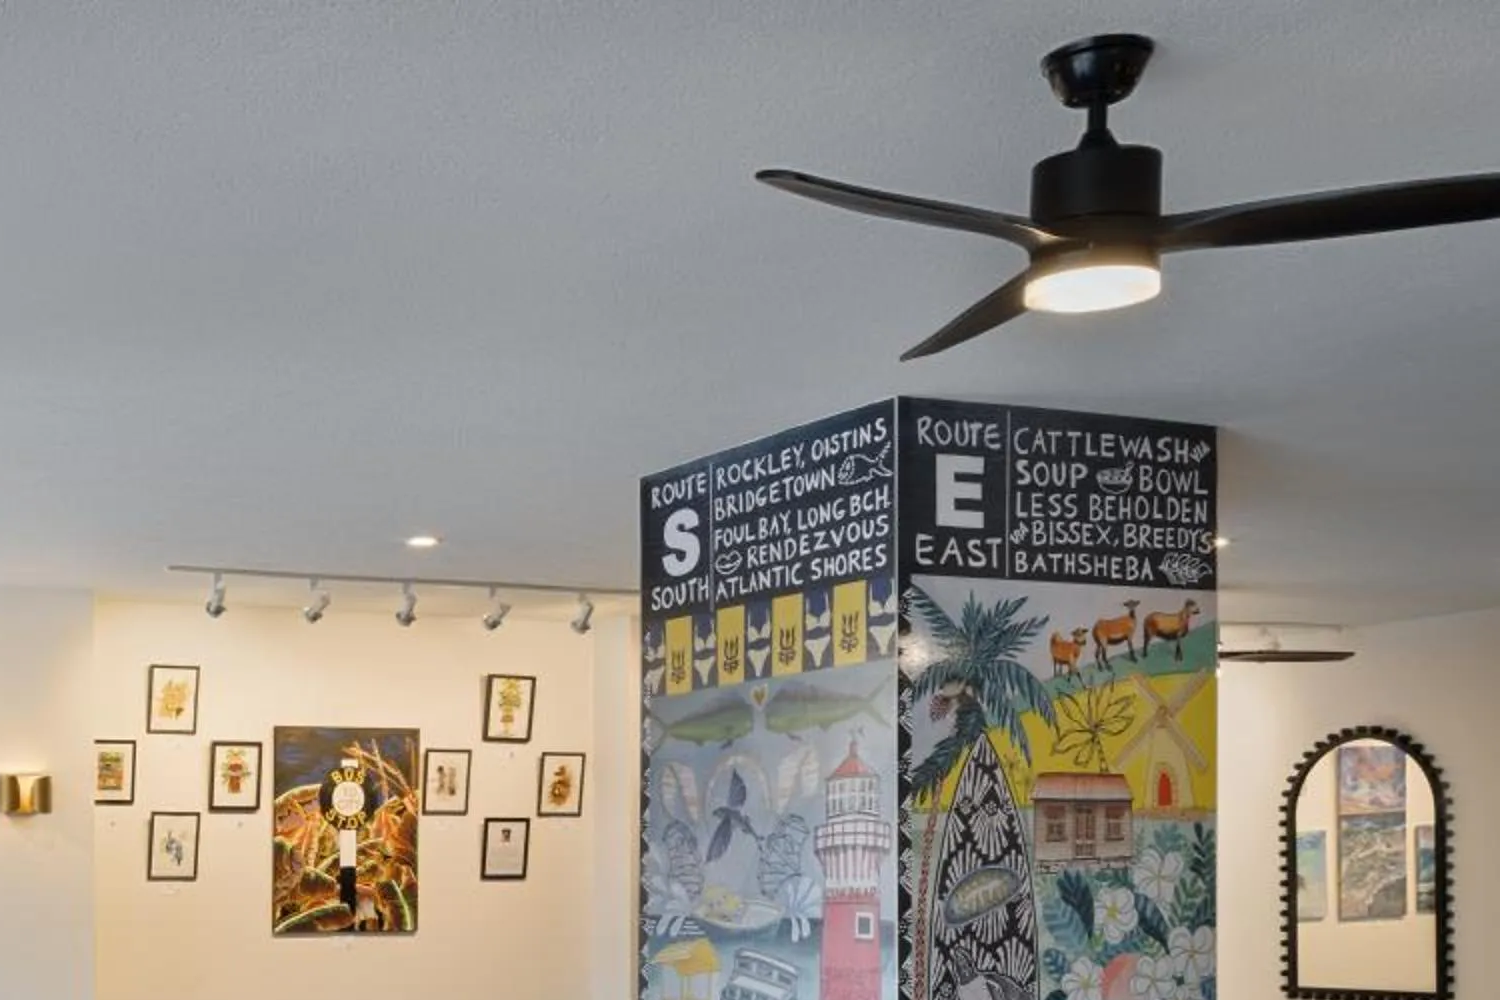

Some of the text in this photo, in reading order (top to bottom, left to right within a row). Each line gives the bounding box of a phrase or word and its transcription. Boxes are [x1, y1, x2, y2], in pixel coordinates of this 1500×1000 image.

[916, 415, 1001, 449] ROUTE
[1013, 427, 1190, 464] CATTLEWASH
[716, 417, 888, 491] ROCKLEY, OISTINS
[650, 471, 708, 509] ROUTE
[714, 463, 837, 522] BRIDGETOWN
[935, 452, 985, 529] E
[1015, 459, 1209, 495] SOUP BOWL
[714, 523, 756, 552] FOUL
[758, 509, 792, 538] BAY,
[797, 497, 847, 532] LONG
[1015, 491, 1208, 525] LESS BEHOLDEN
[661, 507, 701, 578] S
[746, 514, 890, 569] RENDEZVOUS
[915, 533, 1003, 569] EAST
[1031, 521, 1120, 549] BISSEX,
[715, 543, 888, 602] ATLANTIC SHORES
[1014, 551, 1154, 582] BATHSHEBA
[651, 575, 710, 612] SOUTH
[330, 768, 365, 785] BUS
[326, 808, 366, 829] STOP
